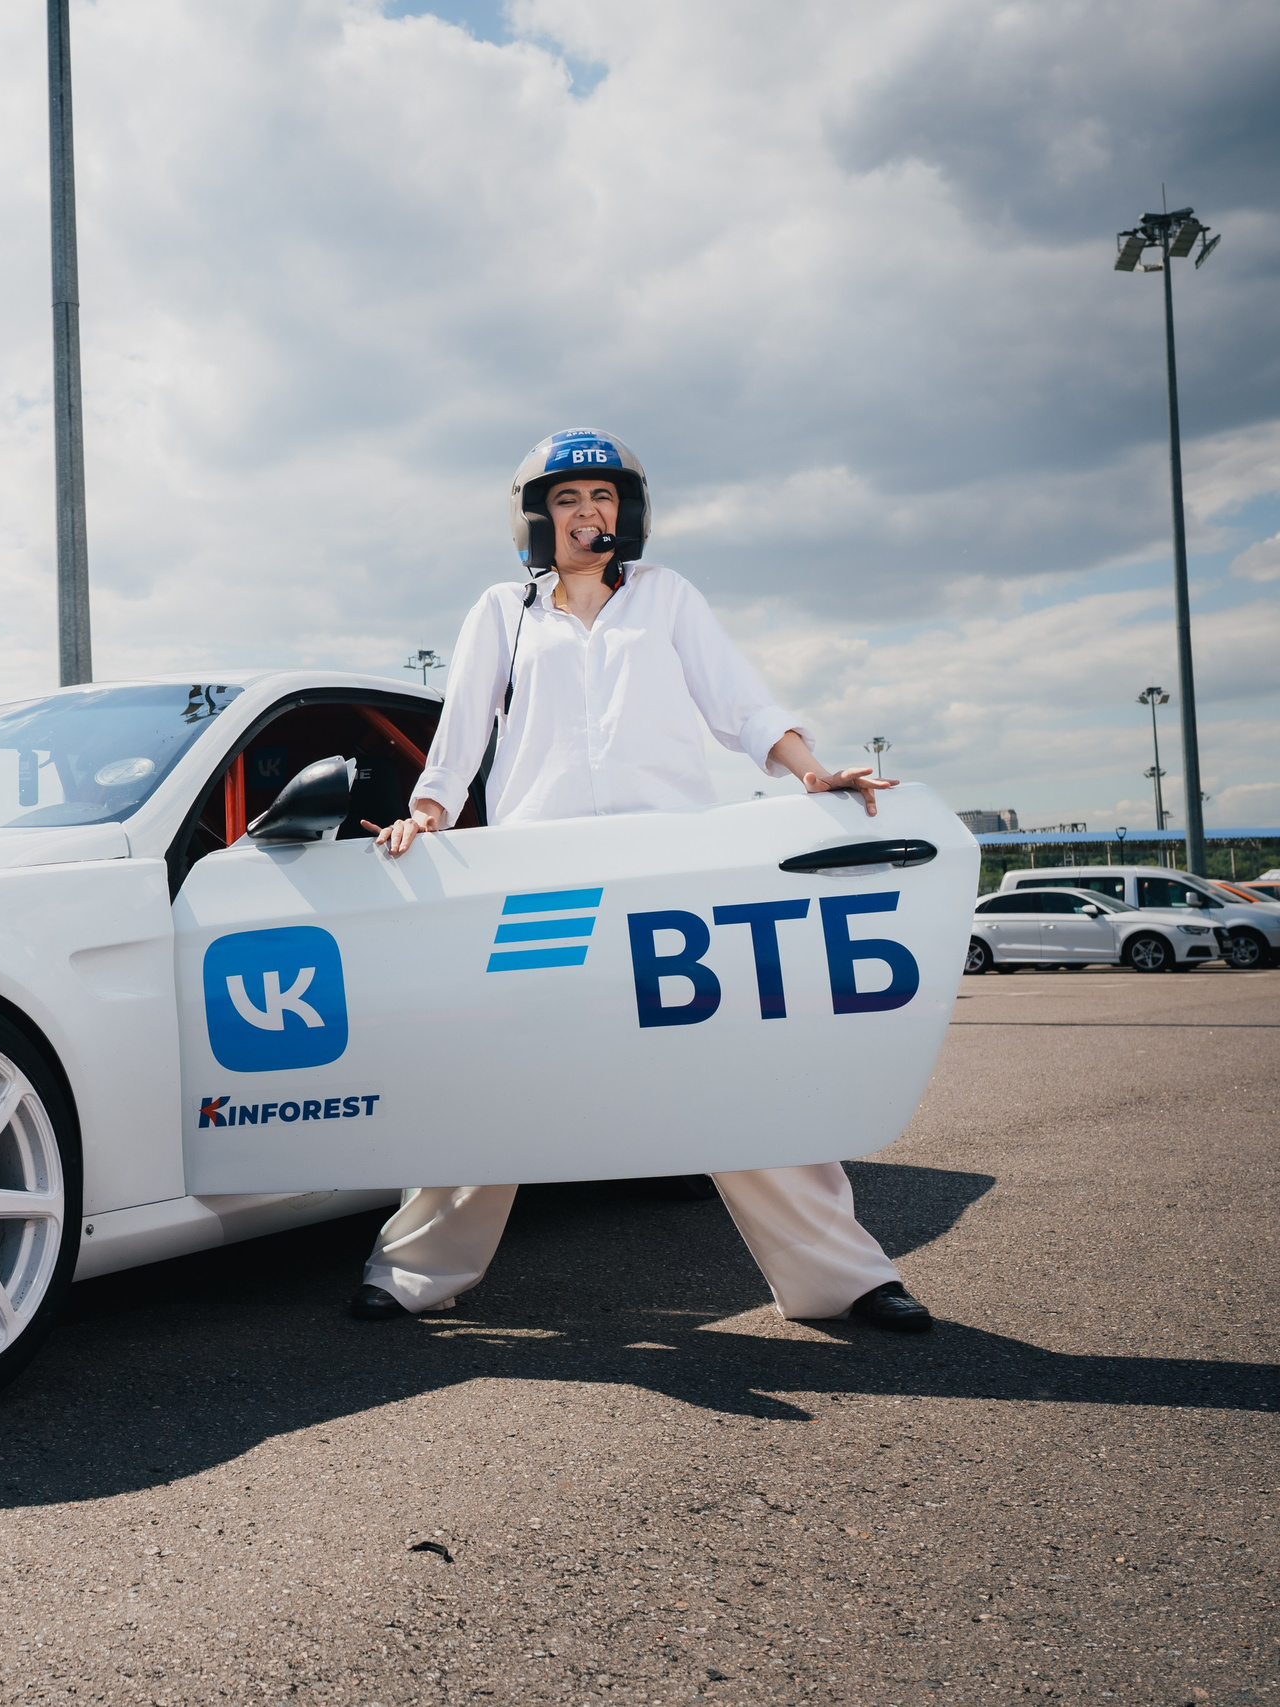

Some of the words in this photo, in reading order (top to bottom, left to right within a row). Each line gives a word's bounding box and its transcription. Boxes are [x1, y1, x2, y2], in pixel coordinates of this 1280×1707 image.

[572, 449, 608, 464] ВТБ
[258, 757, 282, 777] VK
[627, 891, 921, 1029] ВТБ
[225, 967, 326, 1032] VK
